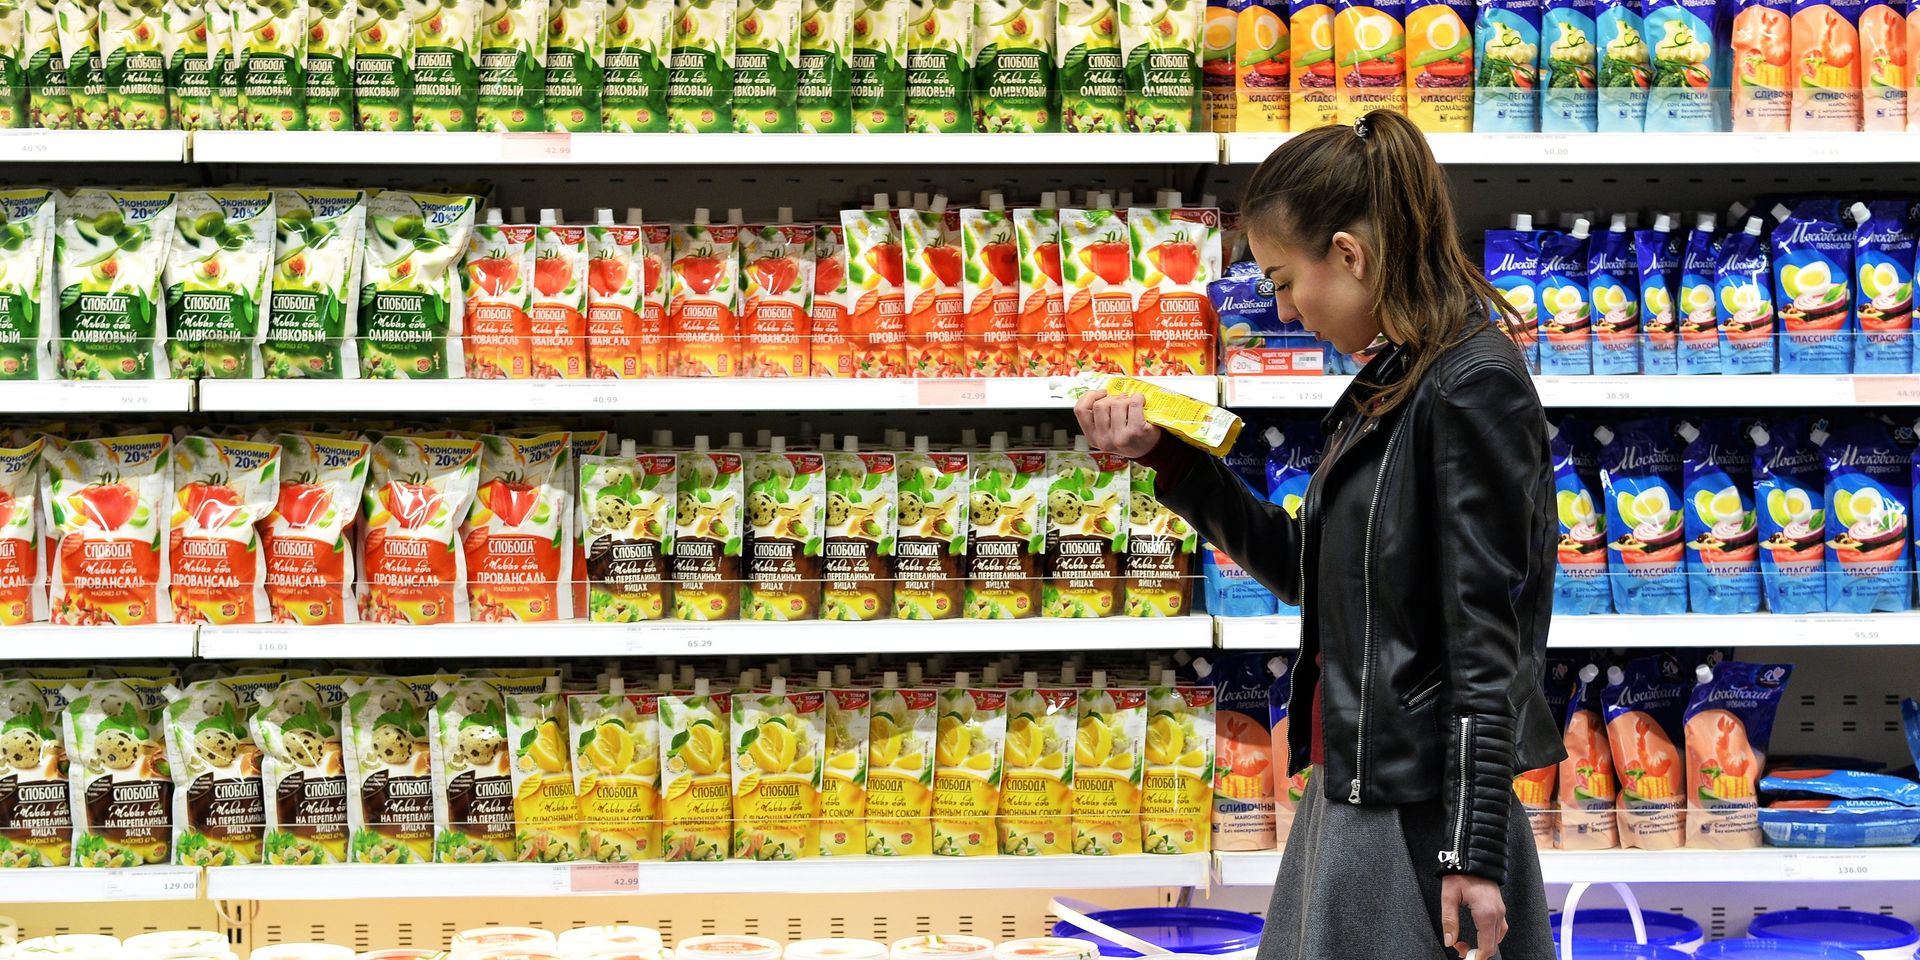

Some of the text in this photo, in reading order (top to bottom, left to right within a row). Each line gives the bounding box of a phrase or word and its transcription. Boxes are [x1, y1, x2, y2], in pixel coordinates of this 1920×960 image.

[126, 56, 162, 68] СЛОБОДА
[249, 59, 285, 70] СЛОБОДА
[356, 60, 393, 71] СЛОБОДА
[908, 56, 946, 68] СЛОБОДА
[998, 56, 1040, 68] СЛОБОДА
[1150, 56, 1188, 68] СЛОБОДА
[989, 84, 1047, 97] ОЛИВКОВЫЙ
[81, 297, 128, 311] СЛОБОДА
[184, 296, 231, 311] СЛОБОДА
[273, 296, 316, 310] СЛОБОДА
[377, 296, 421, 310] СЛОБОДА
[1160, 300, 1199, 311] СЛОБОДА
[477, 309, 512, 320] СЛОБОДА
[683, 306, 718, 317] СЛОБОДА
[757, 307, 793, 318] СЛОБОДА
[76, 314, 131, 329] Живая еда
[179, 313, 235, 329] Живая еда
[372, 313, 426, 329] Живая еда
[72, 328, 137, 343] ОЛИВКОВЫЙ
[176, 327, 241, 342] ОЛИВКОВЫЙ
[369, 327, 432, 342] ОЛИВКОВЫЙ
[961, 392, 986, 400] 42.99
[1299, 392, 1323, 400] 17.59
[1606, 392, 1630, 400] 38.59
[112, 442, 162, 453] Экономия
[84, 543, 132, 558] СЛОБОДА
[183, 543, 227, 558] СЛОБОДА
[273, 542, 314, 557] СЛОБОДА
[384, 542, 428, 557] СЛОБОДА
[489, 539, 535, 554] СЛОБОДА
[613, 545, 653, 559] СЛОБОДА
[677, 544, 713, 557] СЛОБОДА
[754, 545, 793, 557] СЛОБОДА
[826, 544, 866, 557] СЛОБОДА
[898, 543, 938, 556] СЛОБОДА
[976, 543, 1018, 556] СЛОБОДА
[1060, 543, 1101, 555] СЛОБОДА
[1131, 542, 1170, 555] СЛОБОДА
[80, 560, 137, 575] Живая еда
[178, 559, 232, 574] Живая еда
[380, 558, 431, 573] Живая еда
[483, 556, 538, 571] Живая еда
[609, 560, 641, 575] Живая
[970, 557, 1004, 571] Живая
[1056, 556, 1088, 571] Живая
[74, 575, 145, 589] ПРОВАНСАЛЬ
[174, 575, 240, 588] ПРОВАНСАЛЬ
[374, 573, 440, 588] ПРОВАНСАЛЬ
[477, 571, 547, 585] ПРОВАНСАЛЬ
[687, 639, 713, 647] 65.29
[215, 784, 259, 799] СЛОБОДА
[305, 783, 347, 797] СЛОБОДА
[692, 785, 728, 798] СЛОБОДА
[760, 784, 799, 797] СЛОБОДА
[1007, 779, 1046, 791] СЛОБОДА
[1075, 779, 1114, 791] СЛОБОДА
[18, 785, 65, 800] СЛОБОДА
[113, 785, 159, 800] СЛОБОДА
[597, 786, 638, 798] СЛОБОДА
[14, 803, 51, 818] Живая
[108, 802, 164, 818] Живая еда
[829, 809, 855, 818] СОКОМ
[896, 809, 921, 818] СОКОМ
[116, 816, 168, 827] ПЕРЕПЕЛИНЫХ
[125, 827, 151, 837] ЯЙЦАХ
[1838, 866, 1868, 874] 136.00
[164, 882, 195, 890] 129.00
[614, 878, 639, 886] 42.99
